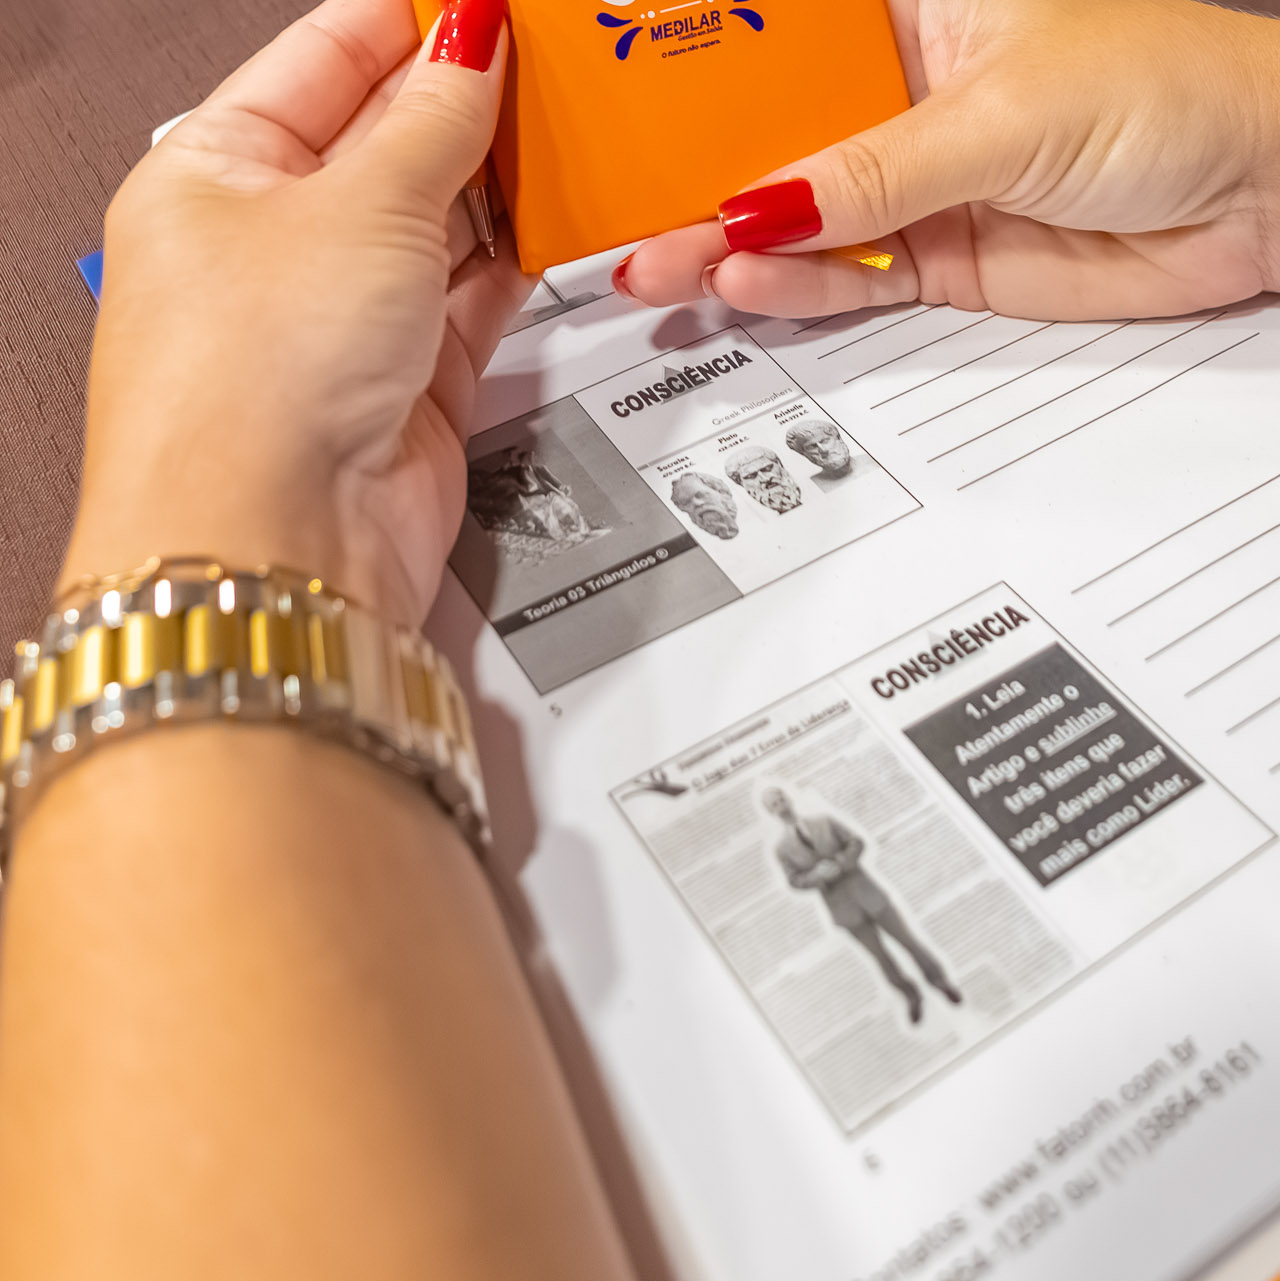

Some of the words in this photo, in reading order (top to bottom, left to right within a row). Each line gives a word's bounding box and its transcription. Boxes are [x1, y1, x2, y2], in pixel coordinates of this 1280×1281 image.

[650, 10, 722, 42] MEDILAR
[610, 349, 753, 418] CONSCIÊNCIA
[712, 410, 741, 426] Greek
[740, 387, 793, 414] Philosophers
[523, 596, 568, 621] Teoria
[568, 586, 587, 603] 03
[586, 554, 657, 593] Triângulos
[870, 604, 1031, 700] CONSCIÊNCIA
[954, 691, 1066, 767] Atentamente
[1063, 683, 1081, 702] o
[982, 679, 1027, 713] Leia
[966, 753, 1027, 799] Artigo
[1024, 744, 1042, 763] e
[1038, 700, 1115, 755] sublinhe
[1003, 779, 1047, 815] três
[1041, 754, 1092, 791] itens
[1087, 732, 1126, 764] que
[1009, 811, 1061, 854] você
[1056, 769, 1126, 821] deveria
[1118, 743, 1169, 783] fazer
[1038, 835, 1091, 880] mais
[1085, 804, 1142, 848] como
